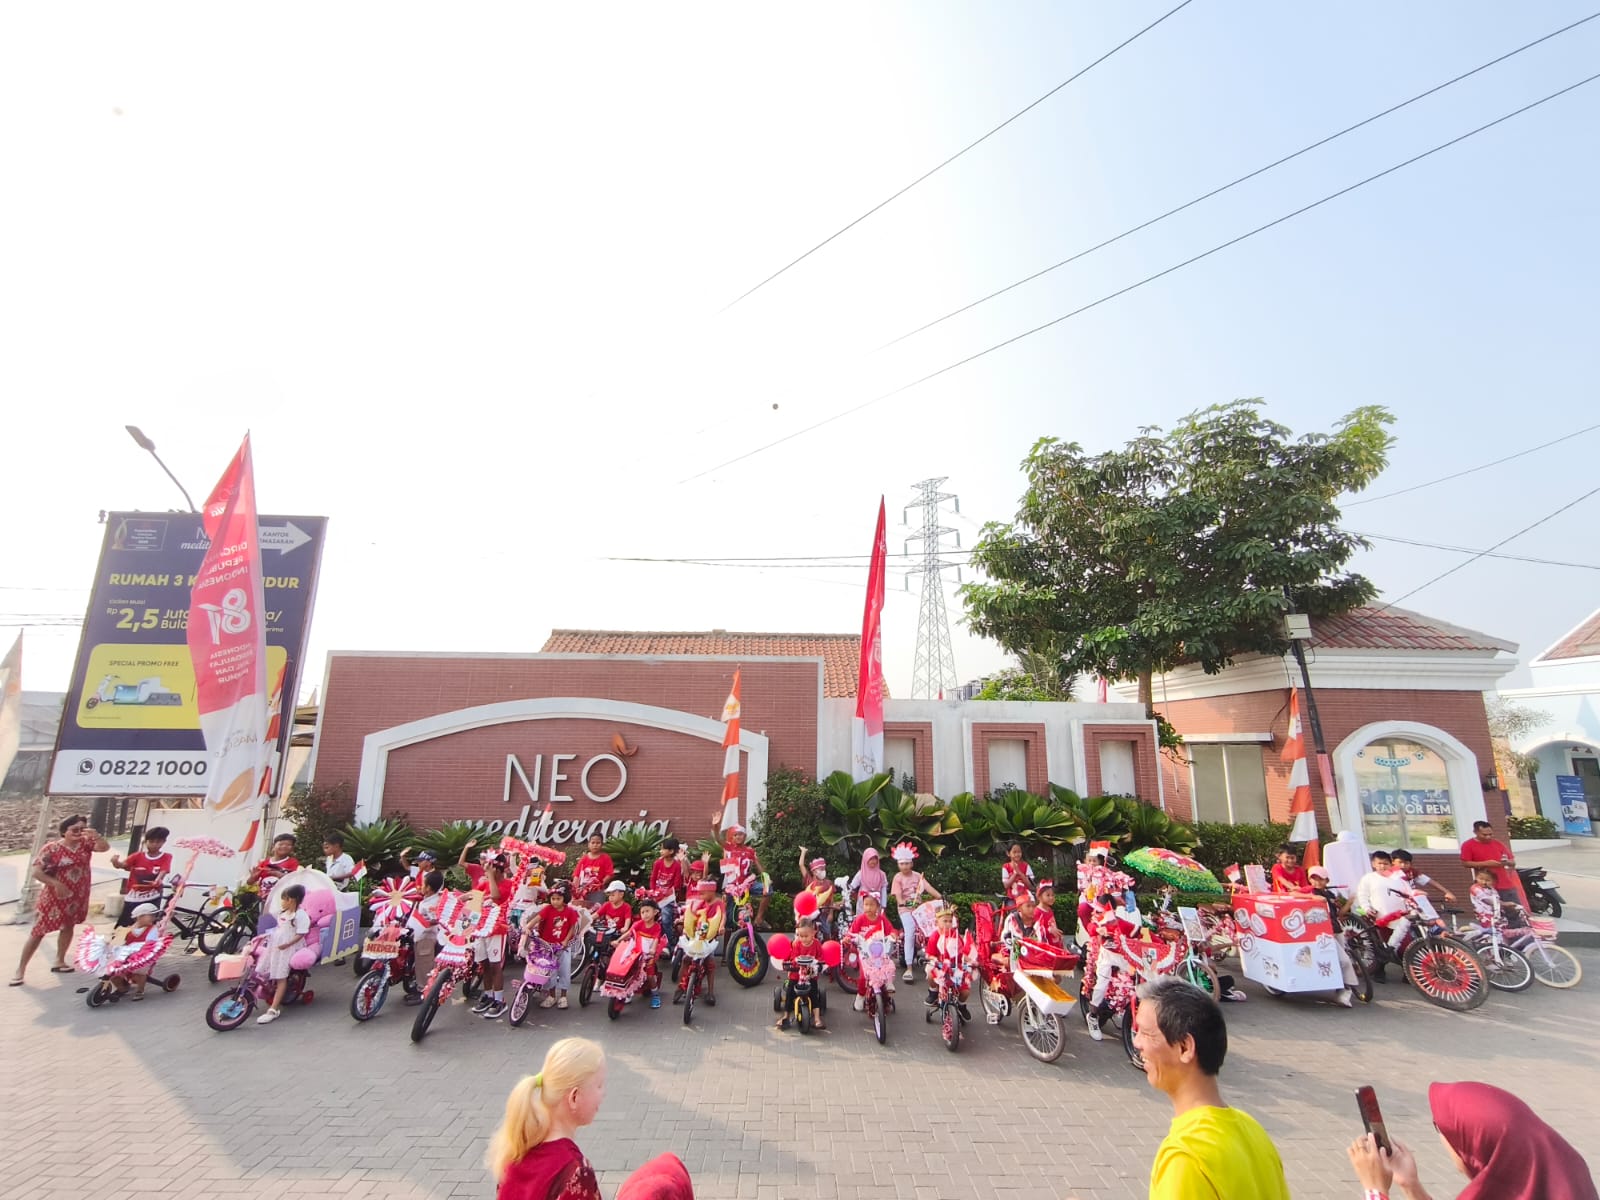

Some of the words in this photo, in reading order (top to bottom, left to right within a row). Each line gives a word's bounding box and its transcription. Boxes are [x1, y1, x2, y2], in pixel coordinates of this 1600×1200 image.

[109, 573, 168, 587] RUMAH
[173, 574, 183, 586] 3
[106, 608, 118, 616] Rp
[115, 607, 160, 633] 2,5
[99, 760, 150, 776] 0822
[156, 760, 207, 776] 1000
[503, 753, 628, 802] NEO
[1371, 803, 1424, 815] KANOR
[1426, 804, 1452, 815] PEM
